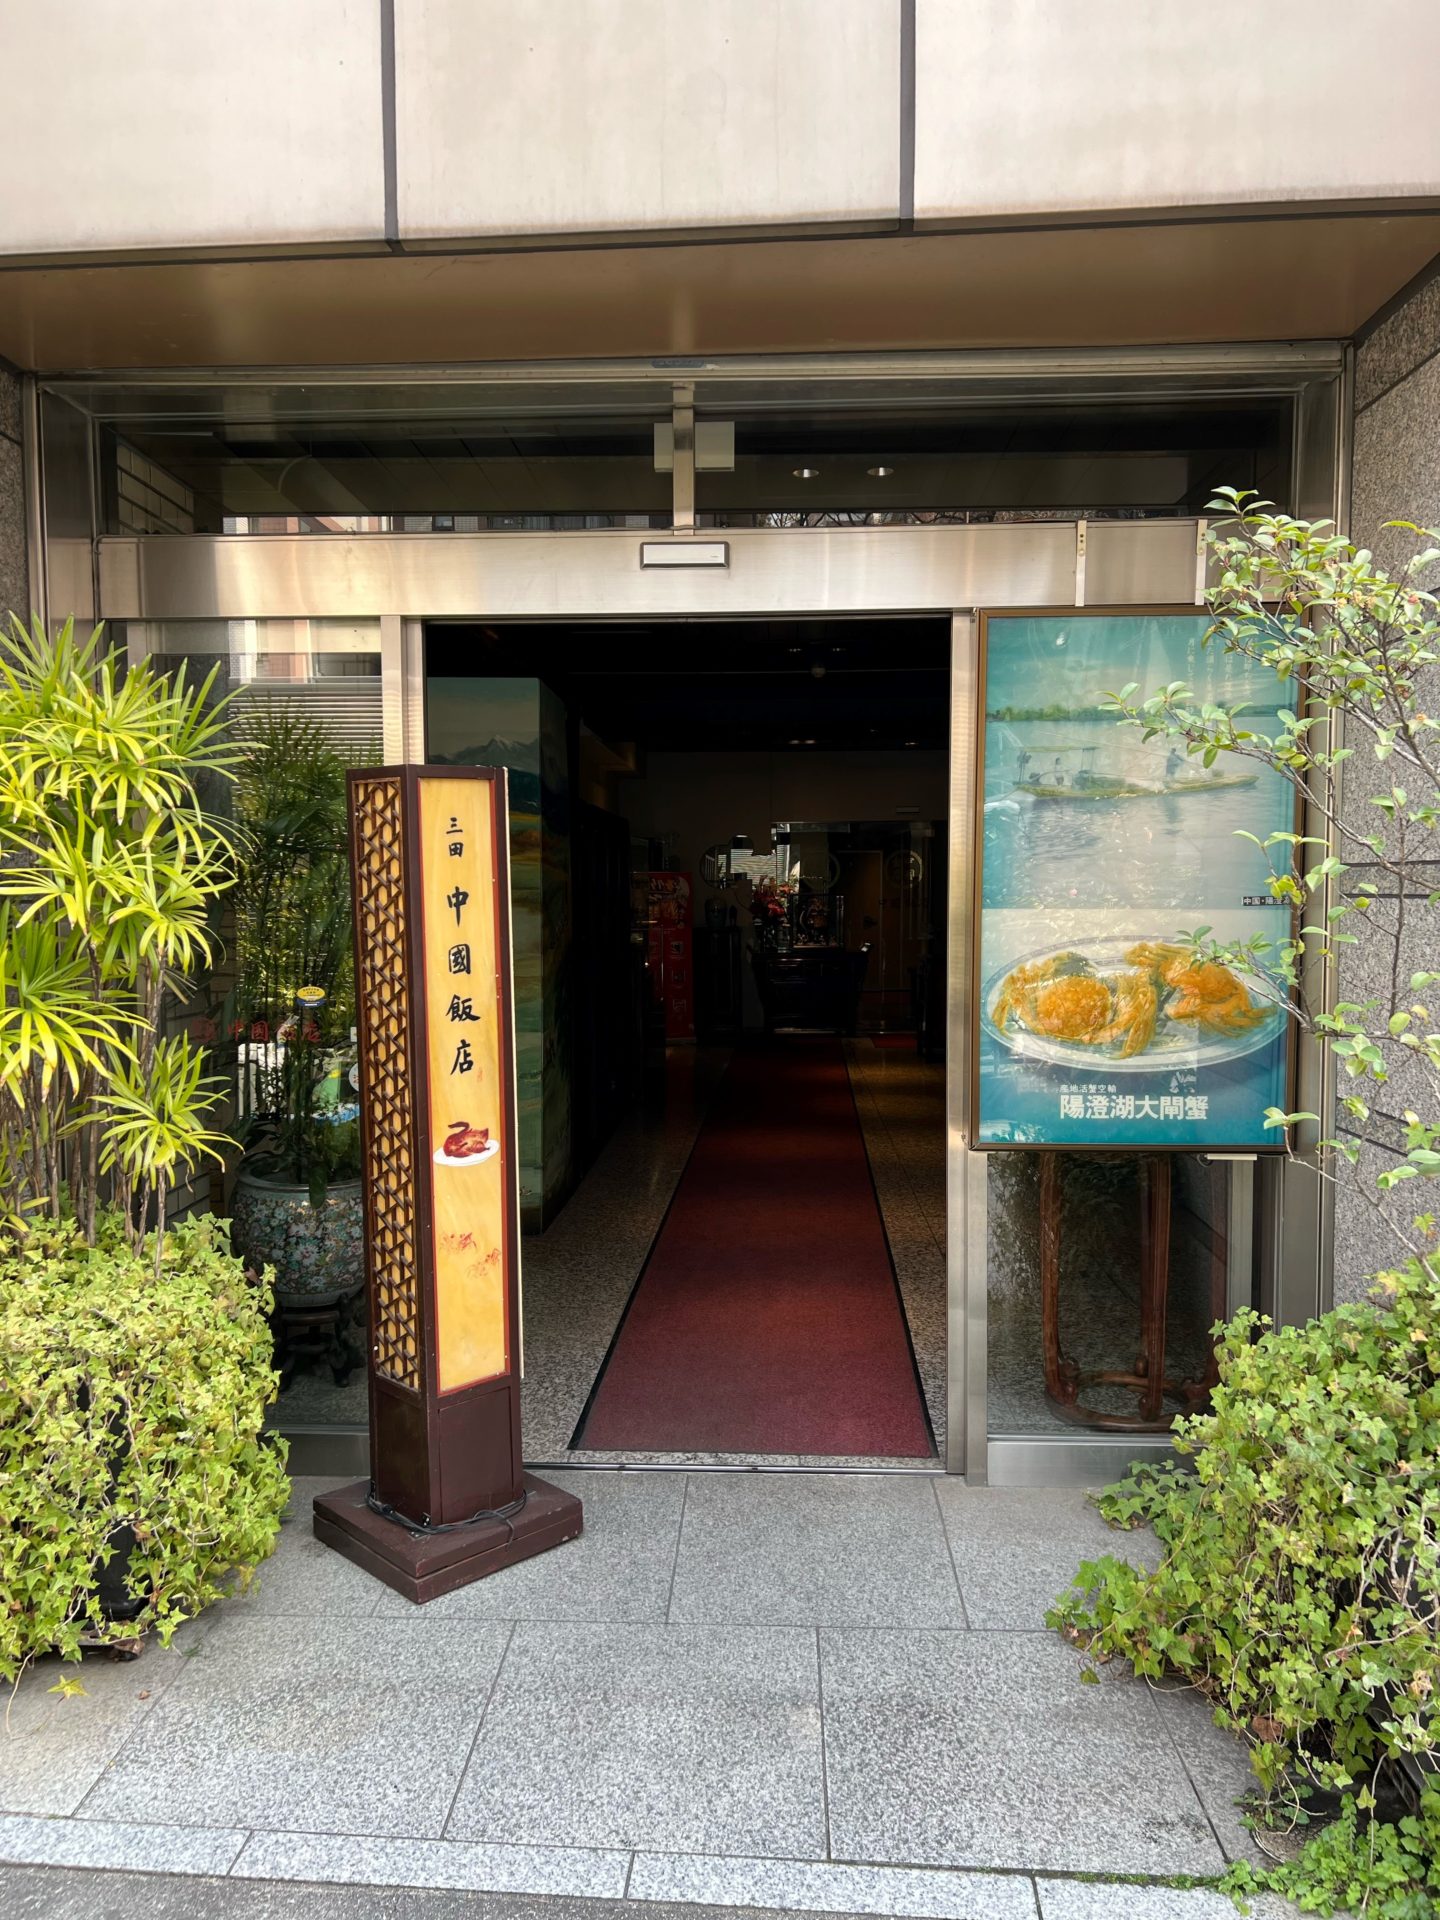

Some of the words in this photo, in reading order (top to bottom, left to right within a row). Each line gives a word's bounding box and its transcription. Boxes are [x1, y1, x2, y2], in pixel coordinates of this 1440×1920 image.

[1059, 1094, 1209, 1120] 陽澄湖大閘蟹
